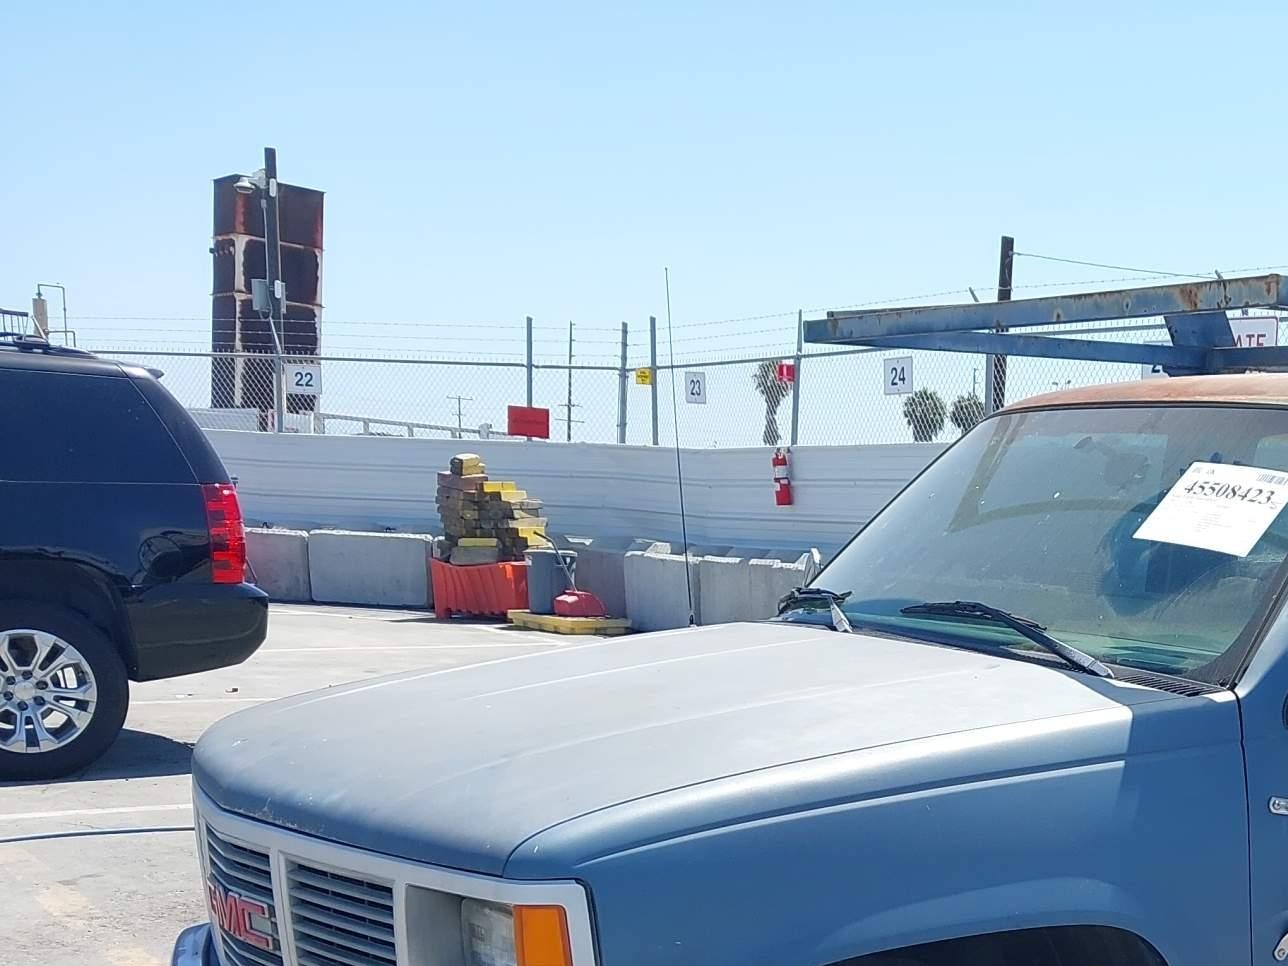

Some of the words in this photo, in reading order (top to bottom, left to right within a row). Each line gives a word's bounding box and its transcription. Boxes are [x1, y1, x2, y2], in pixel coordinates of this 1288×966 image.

[294, 371, 314, 387] 22
[890, 366, 906, 386] 24
[689, 379, 701, 396] 23
[1184, 479, 1275, 505] 45508423
[207, 881, 274, 950] GMC
